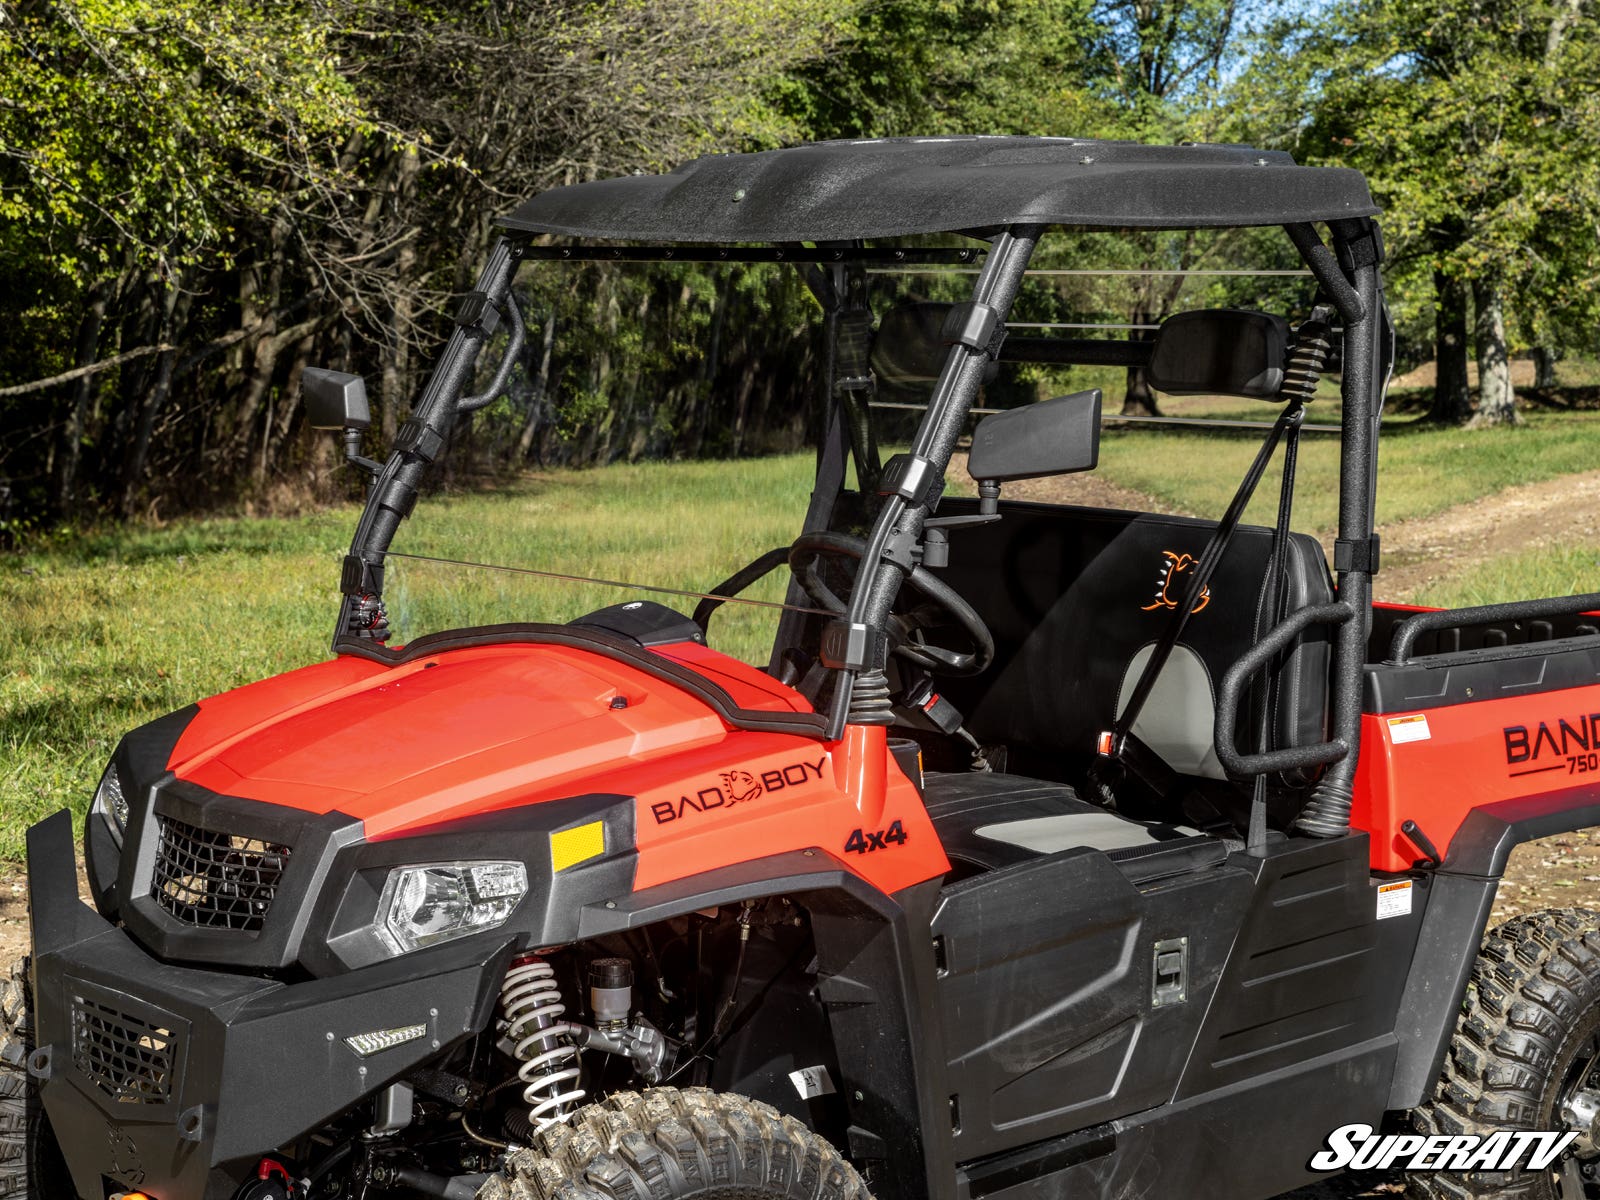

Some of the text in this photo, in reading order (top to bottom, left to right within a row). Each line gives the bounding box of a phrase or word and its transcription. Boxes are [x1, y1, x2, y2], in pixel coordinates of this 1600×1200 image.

[1566, 753, 1598, 775] 750
[651, 757, 826, 824] BAD BOY
[844, 820, 908, 855] 4x4
